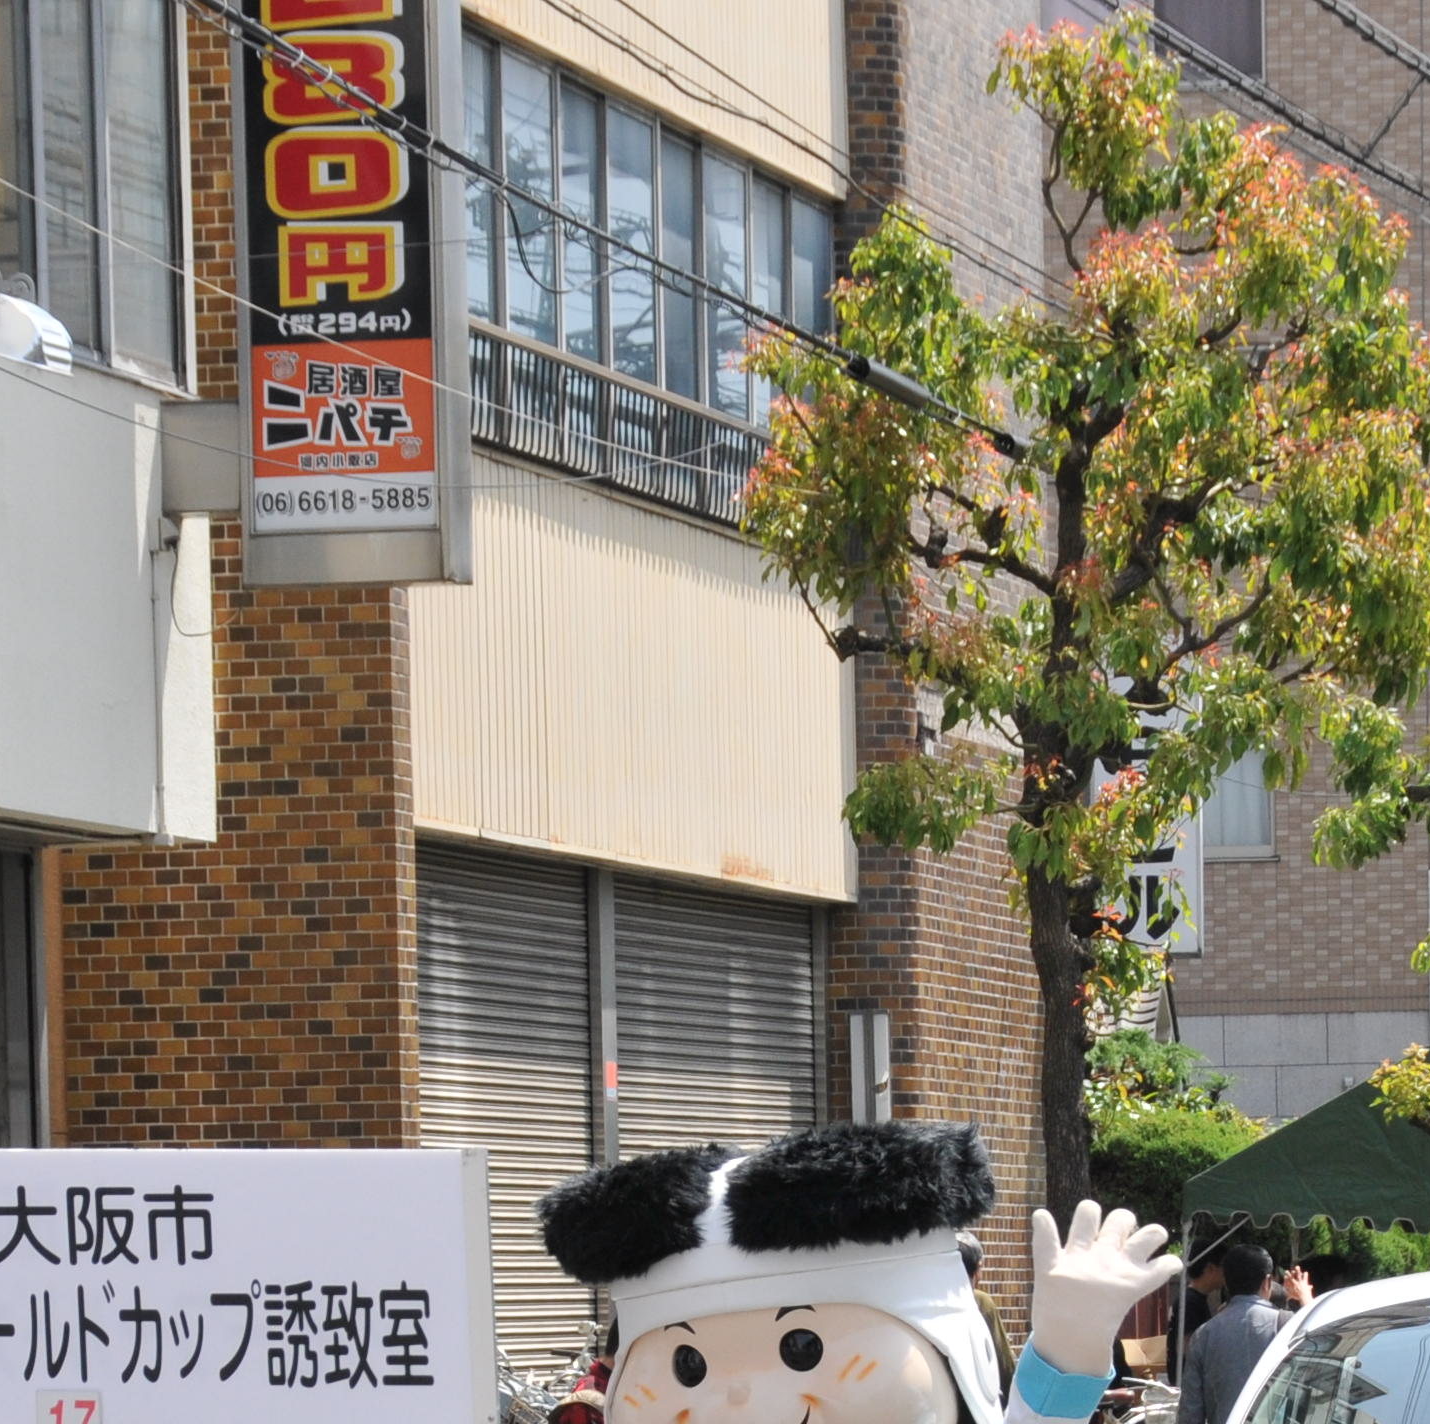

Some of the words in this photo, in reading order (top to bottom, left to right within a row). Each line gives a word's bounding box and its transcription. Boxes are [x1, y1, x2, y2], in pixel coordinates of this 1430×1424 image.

[306, 360, 404, 398] 居酒屋
[263, 379, 413, 451] ニパチ
